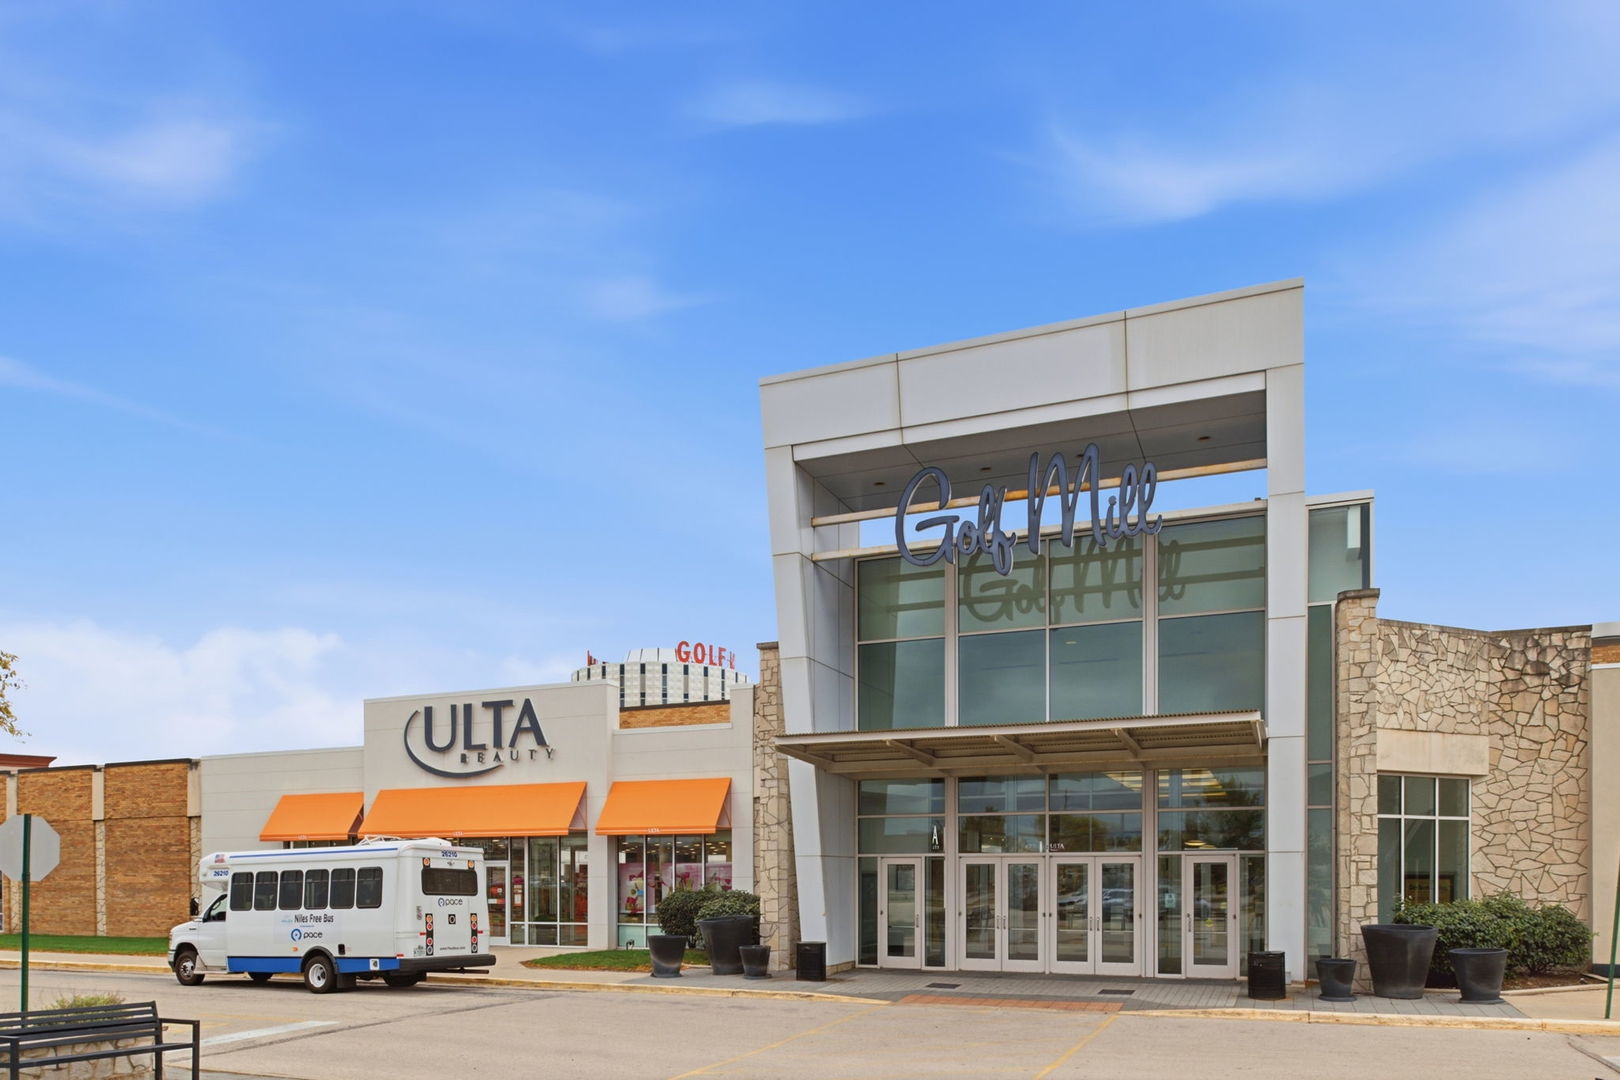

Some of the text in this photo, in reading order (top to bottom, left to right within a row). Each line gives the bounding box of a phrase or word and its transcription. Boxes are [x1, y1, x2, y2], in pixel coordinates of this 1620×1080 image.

[895, 442, 1164, 576] Golf Mill
[677, 640, 727, 667] GOLF
[423, 697, 551, 753] ULTA
[460, 748, 556, 764] BEAUTY
[441, 850, 458, 858] 26210
[446, 898, 464, 906] pace
[294, 913, 309, 923] Niles
[310, 913, 323, 923] Free
[323, 913, 334, 923] Bus
[303, 931, 323, 939] pace
